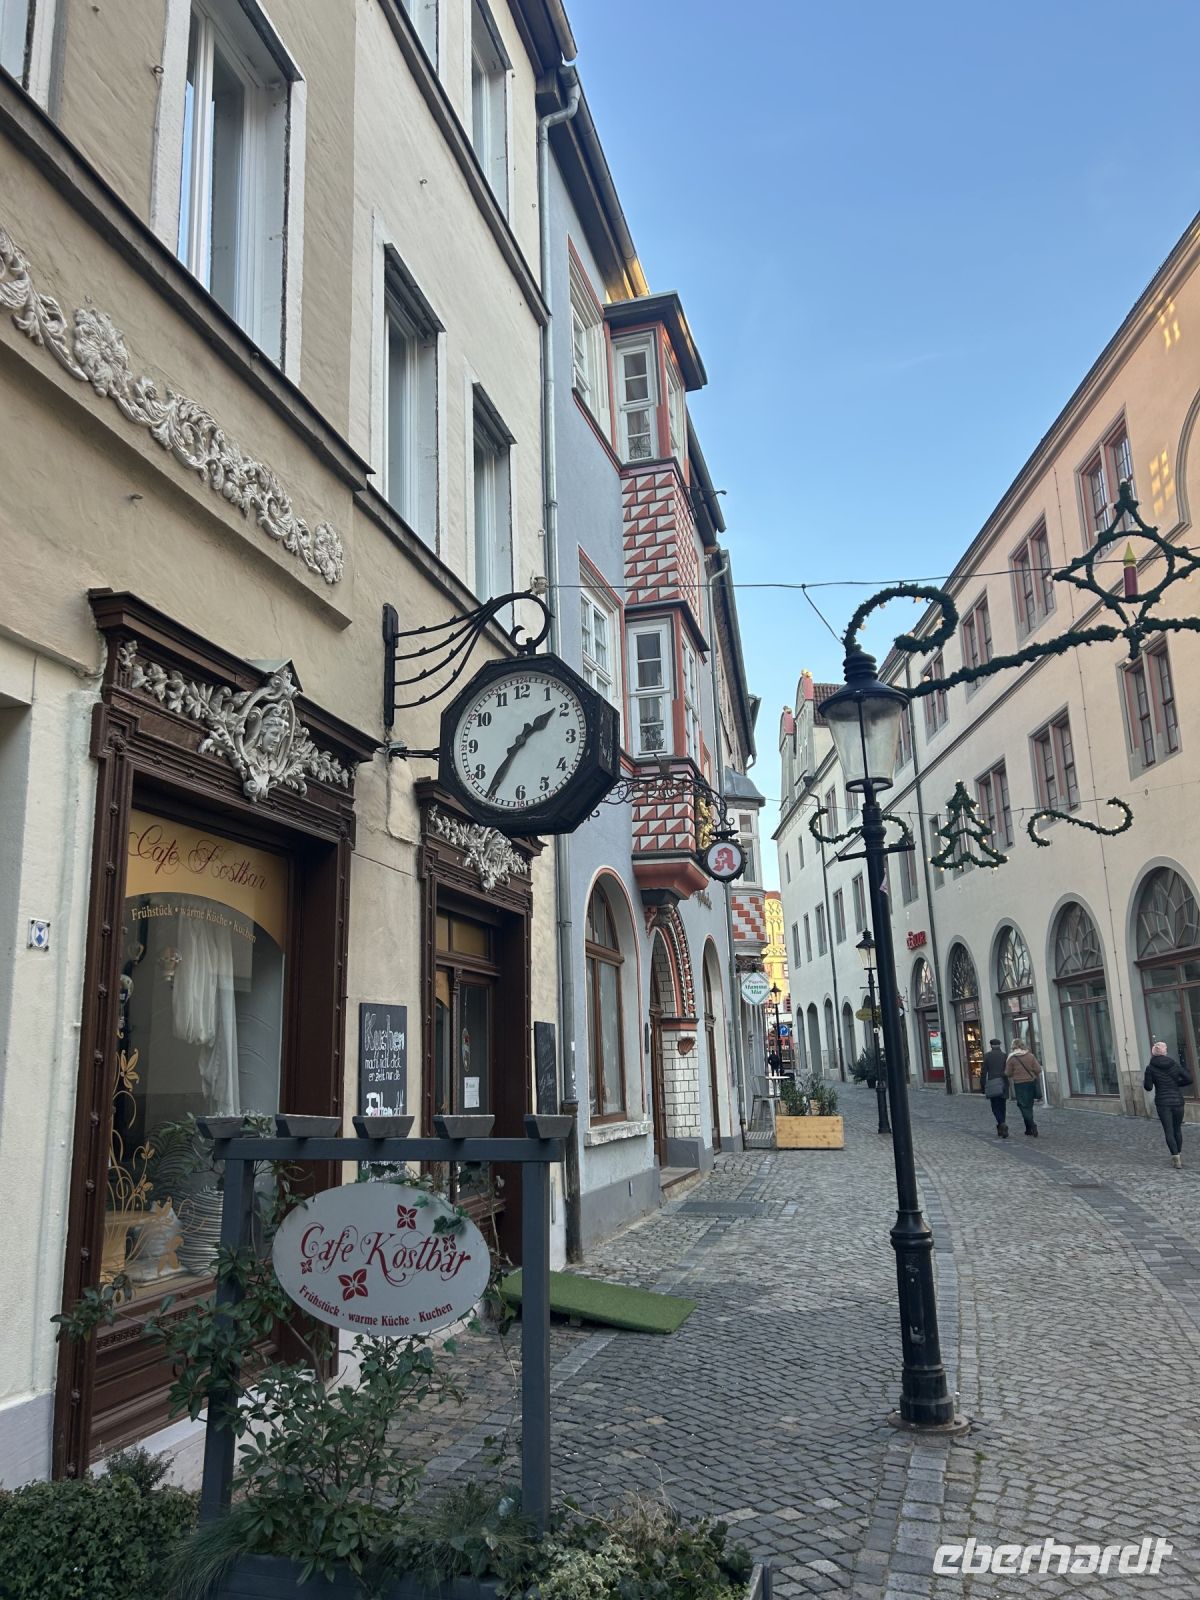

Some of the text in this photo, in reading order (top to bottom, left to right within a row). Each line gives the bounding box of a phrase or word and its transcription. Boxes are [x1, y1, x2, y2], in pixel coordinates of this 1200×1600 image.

[496, 692, 508, 707] 11
[513, 684, 531, 700] 12
[543, 687, 551, 701] 1
[558, 702, 570, 718] 2
[476, 712, 492, 727] 10
[566, 728, 577, 744] 3
[468, 739, 479, 754] 9
[475, 764, 486, 780] 8
[556, 757, 569, 772] 4
[540, 776, 550, 791] 5
[515, 785, 526, 800] 6
[131, 904, 173, 921] Frühstück
[360, 1230, 472, 1287] Kostbar
[298, 1284, 454, 1326] Frühstück warme Küche Kuchen
